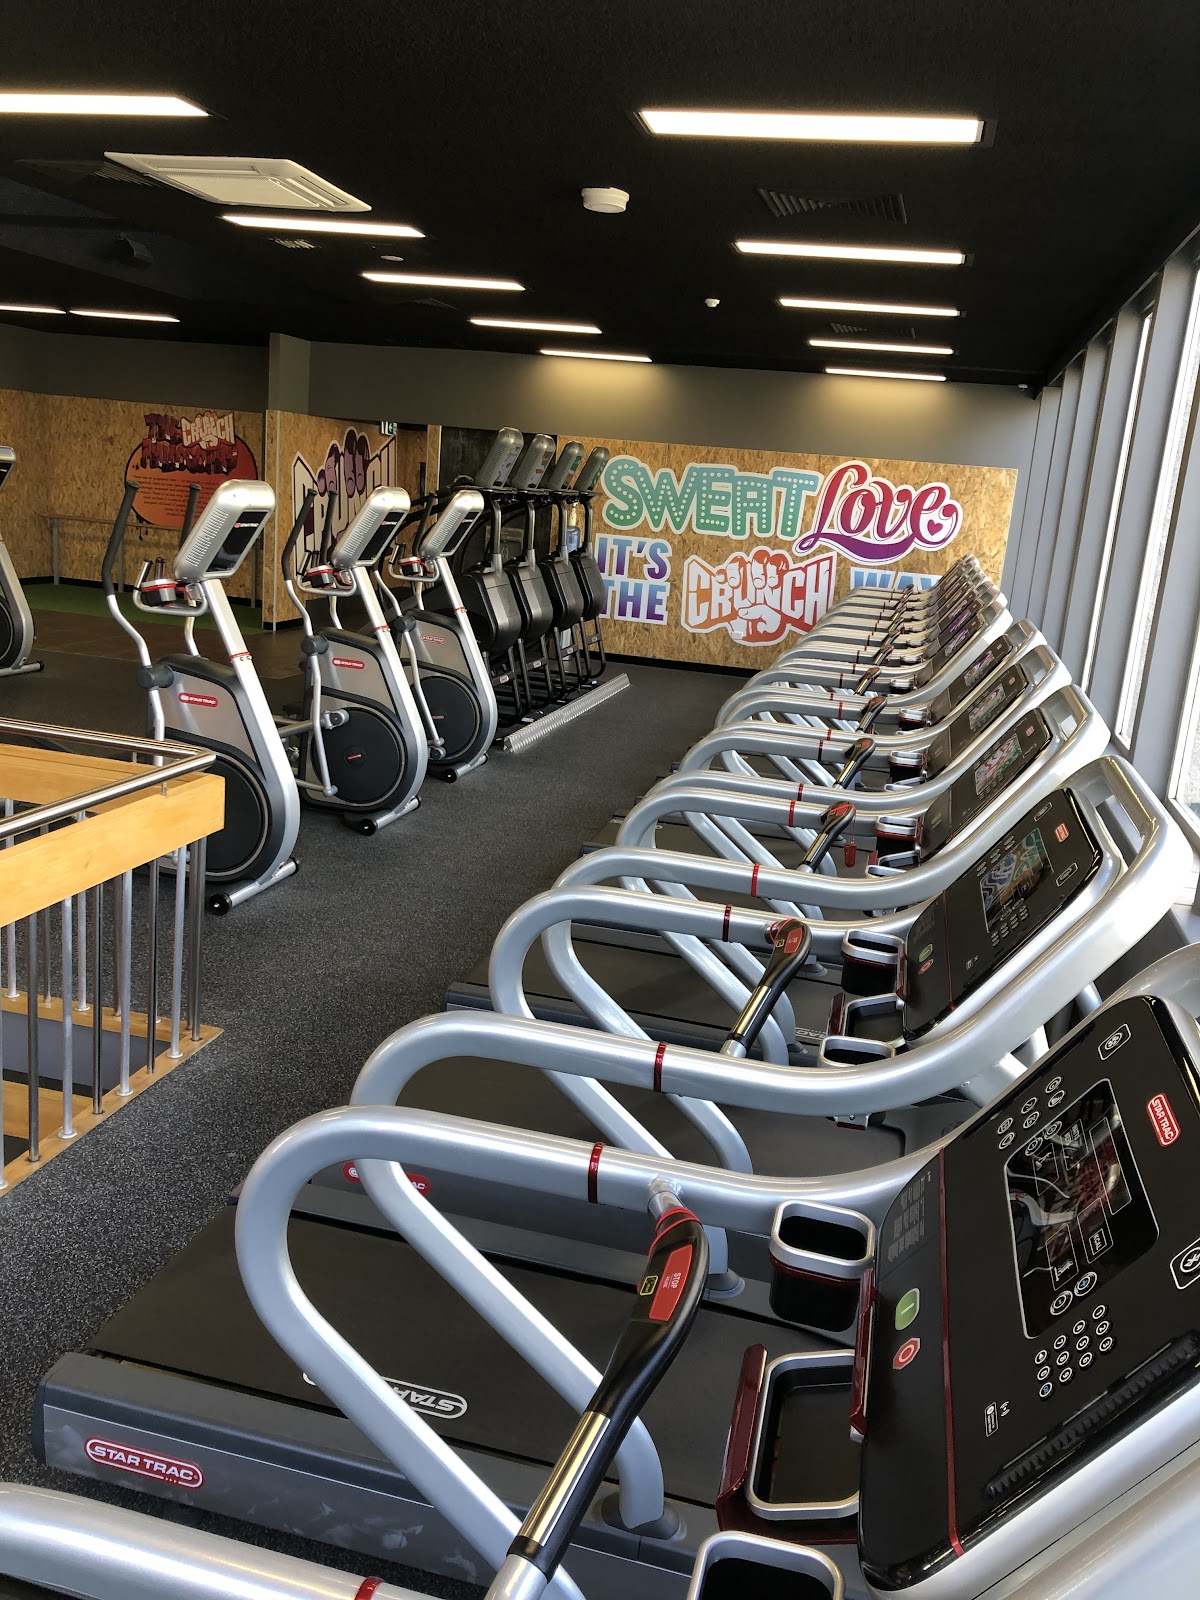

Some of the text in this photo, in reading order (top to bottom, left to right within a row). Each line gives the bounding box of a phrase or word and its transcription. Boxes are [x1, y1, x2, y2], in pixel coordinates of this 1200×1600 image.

[181, 411, 235, 450] CRUNCH
[604, 457, 960, 560] SWEAT Love
[597, 537, 669, 580] IT'S
[687, 551, 833, 632] CRUNCH
[1152, 1098, 1175, 1140] STAR TRAC
[671, 1272, 682, 1289] STOP
[94, 1445, 194, 1481] STAR TRAC
